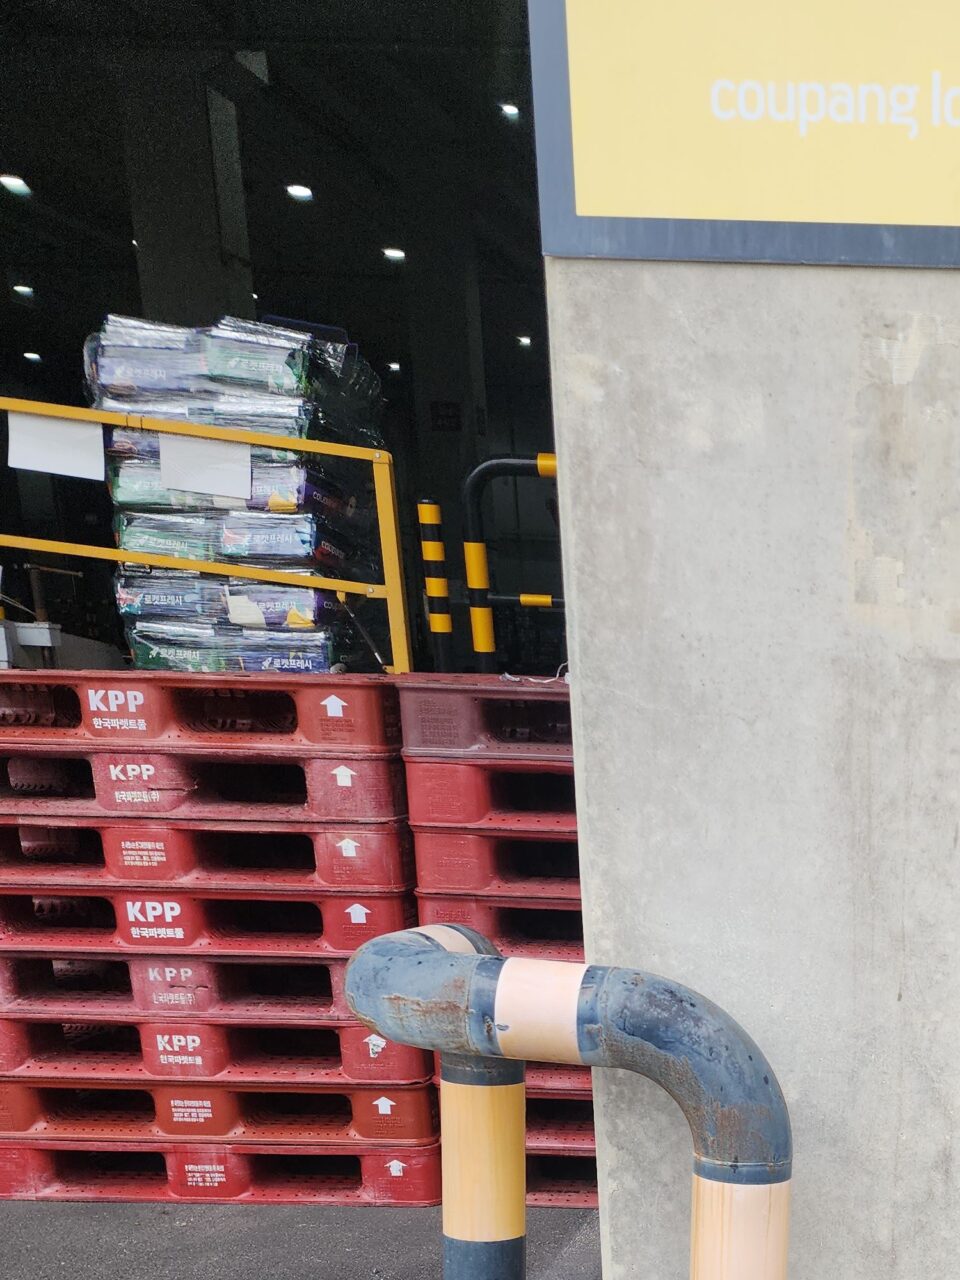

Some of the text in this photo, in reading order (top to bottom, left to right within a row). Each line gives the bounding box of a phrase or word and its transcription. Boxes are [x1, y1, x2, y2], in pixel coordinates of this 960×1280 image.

[709, 77, 919, 138] coupang
[252, 534, 293, 545] 로켓프레시
[144, 593, 183, 606] 로켓프레시
[160, 649, 200, 660] 로켓프레시
[273, 658, 313, 670] 로켓프레시
[87, 689, 144, 712] KPP
[109, 764, 155, 781] KPP
[126, 901, 181, 922] KPP
[130, 927, 185, 939] 한국파렛트풀
[148, 967, 192, 982] KPP
[156, 1034, 201, 1052] KPP
